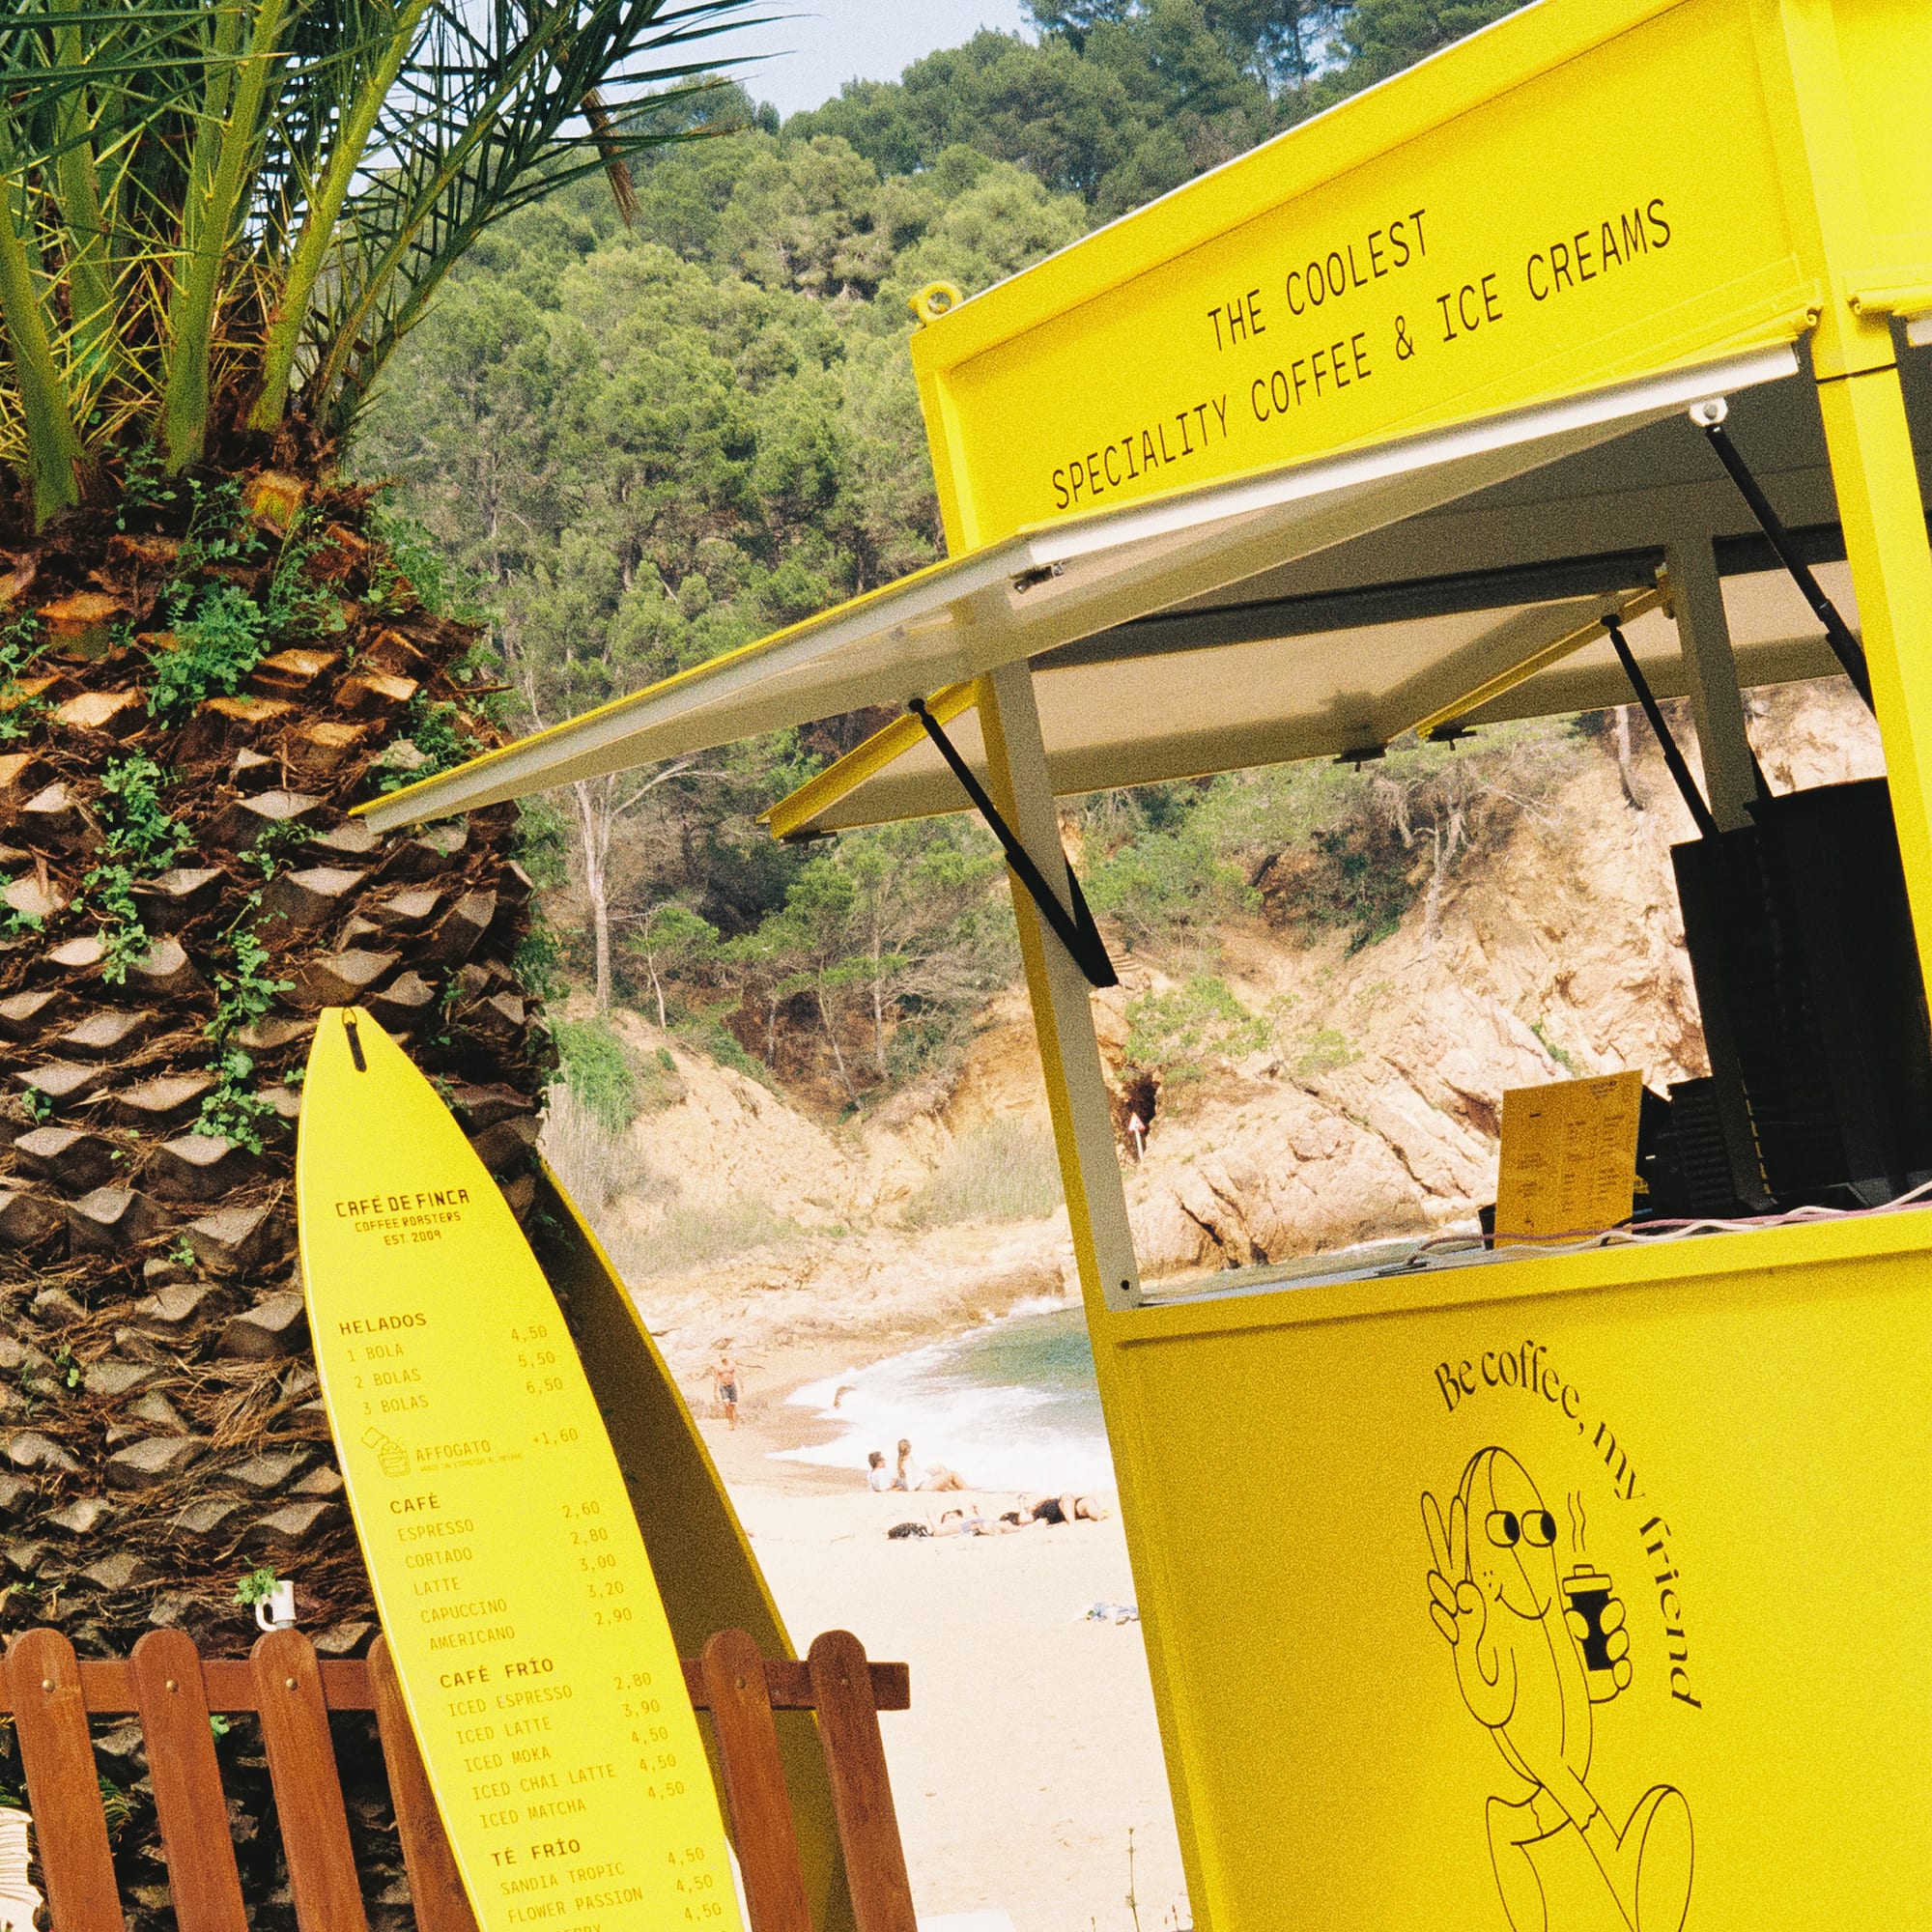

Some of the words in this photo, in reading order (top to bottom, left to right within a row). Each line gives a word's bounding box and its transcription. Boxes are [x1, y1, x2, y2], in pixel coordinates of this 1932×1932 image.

[1208, 289, 1265, 352] THE
[1287, 209, 1428, 317] COOLEST
[1051, 395, 1228, 510] SPECIALITY
[1251, 332, 1372, 422] COFFEE
[1395, 315, 1415, 361] &
[1435, 273, 1503, 343] ICE
[1525, 198, 1671, 302] CREAMS
[336, 1197, 383, 1217] CAFÉ
[388, 1194, 412, 1211] DE
[416, 1189, 469, 1208] FINCA
[355, 1218, 400, 1233] COFFEE
[402, 1211, 462, 1228] ROASTERS
[384, 1234, 409, 1246] EST.
[412, 1230, 442, 1242] 2009
[339, 1313, 427, 1335] HELADOS
[348, 1349, 355, 1362] 1
[365, 1343, 404, 1360] BOLA
[511, 1325, 548, 1343] 4,50
[354, 1376, 363, 1389] 2
[373, 1368, 421, 1386] BOLAS
[518, 1351, 555, 1369] 5,50
[363, 1403, 371, 1415] 3
[381, 1395, 429, 1412] BOLAS
[526, 1378, 563, 1395] 6,50
[416, 1439, 492, 1463] AFFOGATO
[389, 1492, 441, 1515] CAFÉ
[398, 1519, 473, 1542] ESPRESSO
[562, 1501, 601, 1519] 2,60
[1435, 1358, 1476, 1413] Be
[1481, 1339, 1584, 1435] coffee,
[1593, 1421, 1646, 1501] my
[1639, 1516, 1702, 1710] friend
[406, 1548, 472, 1569] CORTADO
[570, 1527, 609, 1546] 2,80
[413, 1577, 462, 1596] LATTE
[579, 1554, 616, 1573] 3,00
[421, 1599, 508, 1623] CAPUCCINO
[587, 1580, 624, 1600] 3,20
[429, 1626, 516, 1652] AMERICANO
[595, 1607, 632, 1626] 2,90
[440, 1665, 490, 1689] CAFÉ
[504, 1657, 554, 1679] FRÍO
[448, 1698, 487, 1718] ICED
[496, 1685, 572, 1710] ESPRESSO
[613, 1671, 651, 1690] 2,80
[456, 1727, 495, 1745] ICED
[504, 1717, 553, 1737] LATTE
[622, 1699, 660, 1718] 3,90
[464, 1754, 502, 1774] ICED
[512, 1747, 551, 1764] MOKA
[632, 1726, 668, 1745] 4,50
[472, 1782, 510, 1801] ICED
[520, 1774, 558, 1792] CHAI
[568, 1764, 615, 1784] LATTE
[639, 1753, 676, 1773] 4,50
[480, 1810, 519, 1830] ICED
[527, 1799, 587, 1820] MATCHA
[647, 1781, 684, 1801] 4,50
[491, 1846, 515, 1867] TÉ
[531, 1838, 581, 1861] FRÍO
[500, 1875, 558, 1895] SANDIA
[567, 1862, 625, 1884] TROPIC
[668, 1847, 704, 1866] 4,50
[508, 1901, 566, 1924] FLOWER
[576, 1888, 643, 1911] PASSION
[676, 1874, 713, 1893] 4,50
[684, 1902, 722, 1922] 4,50
